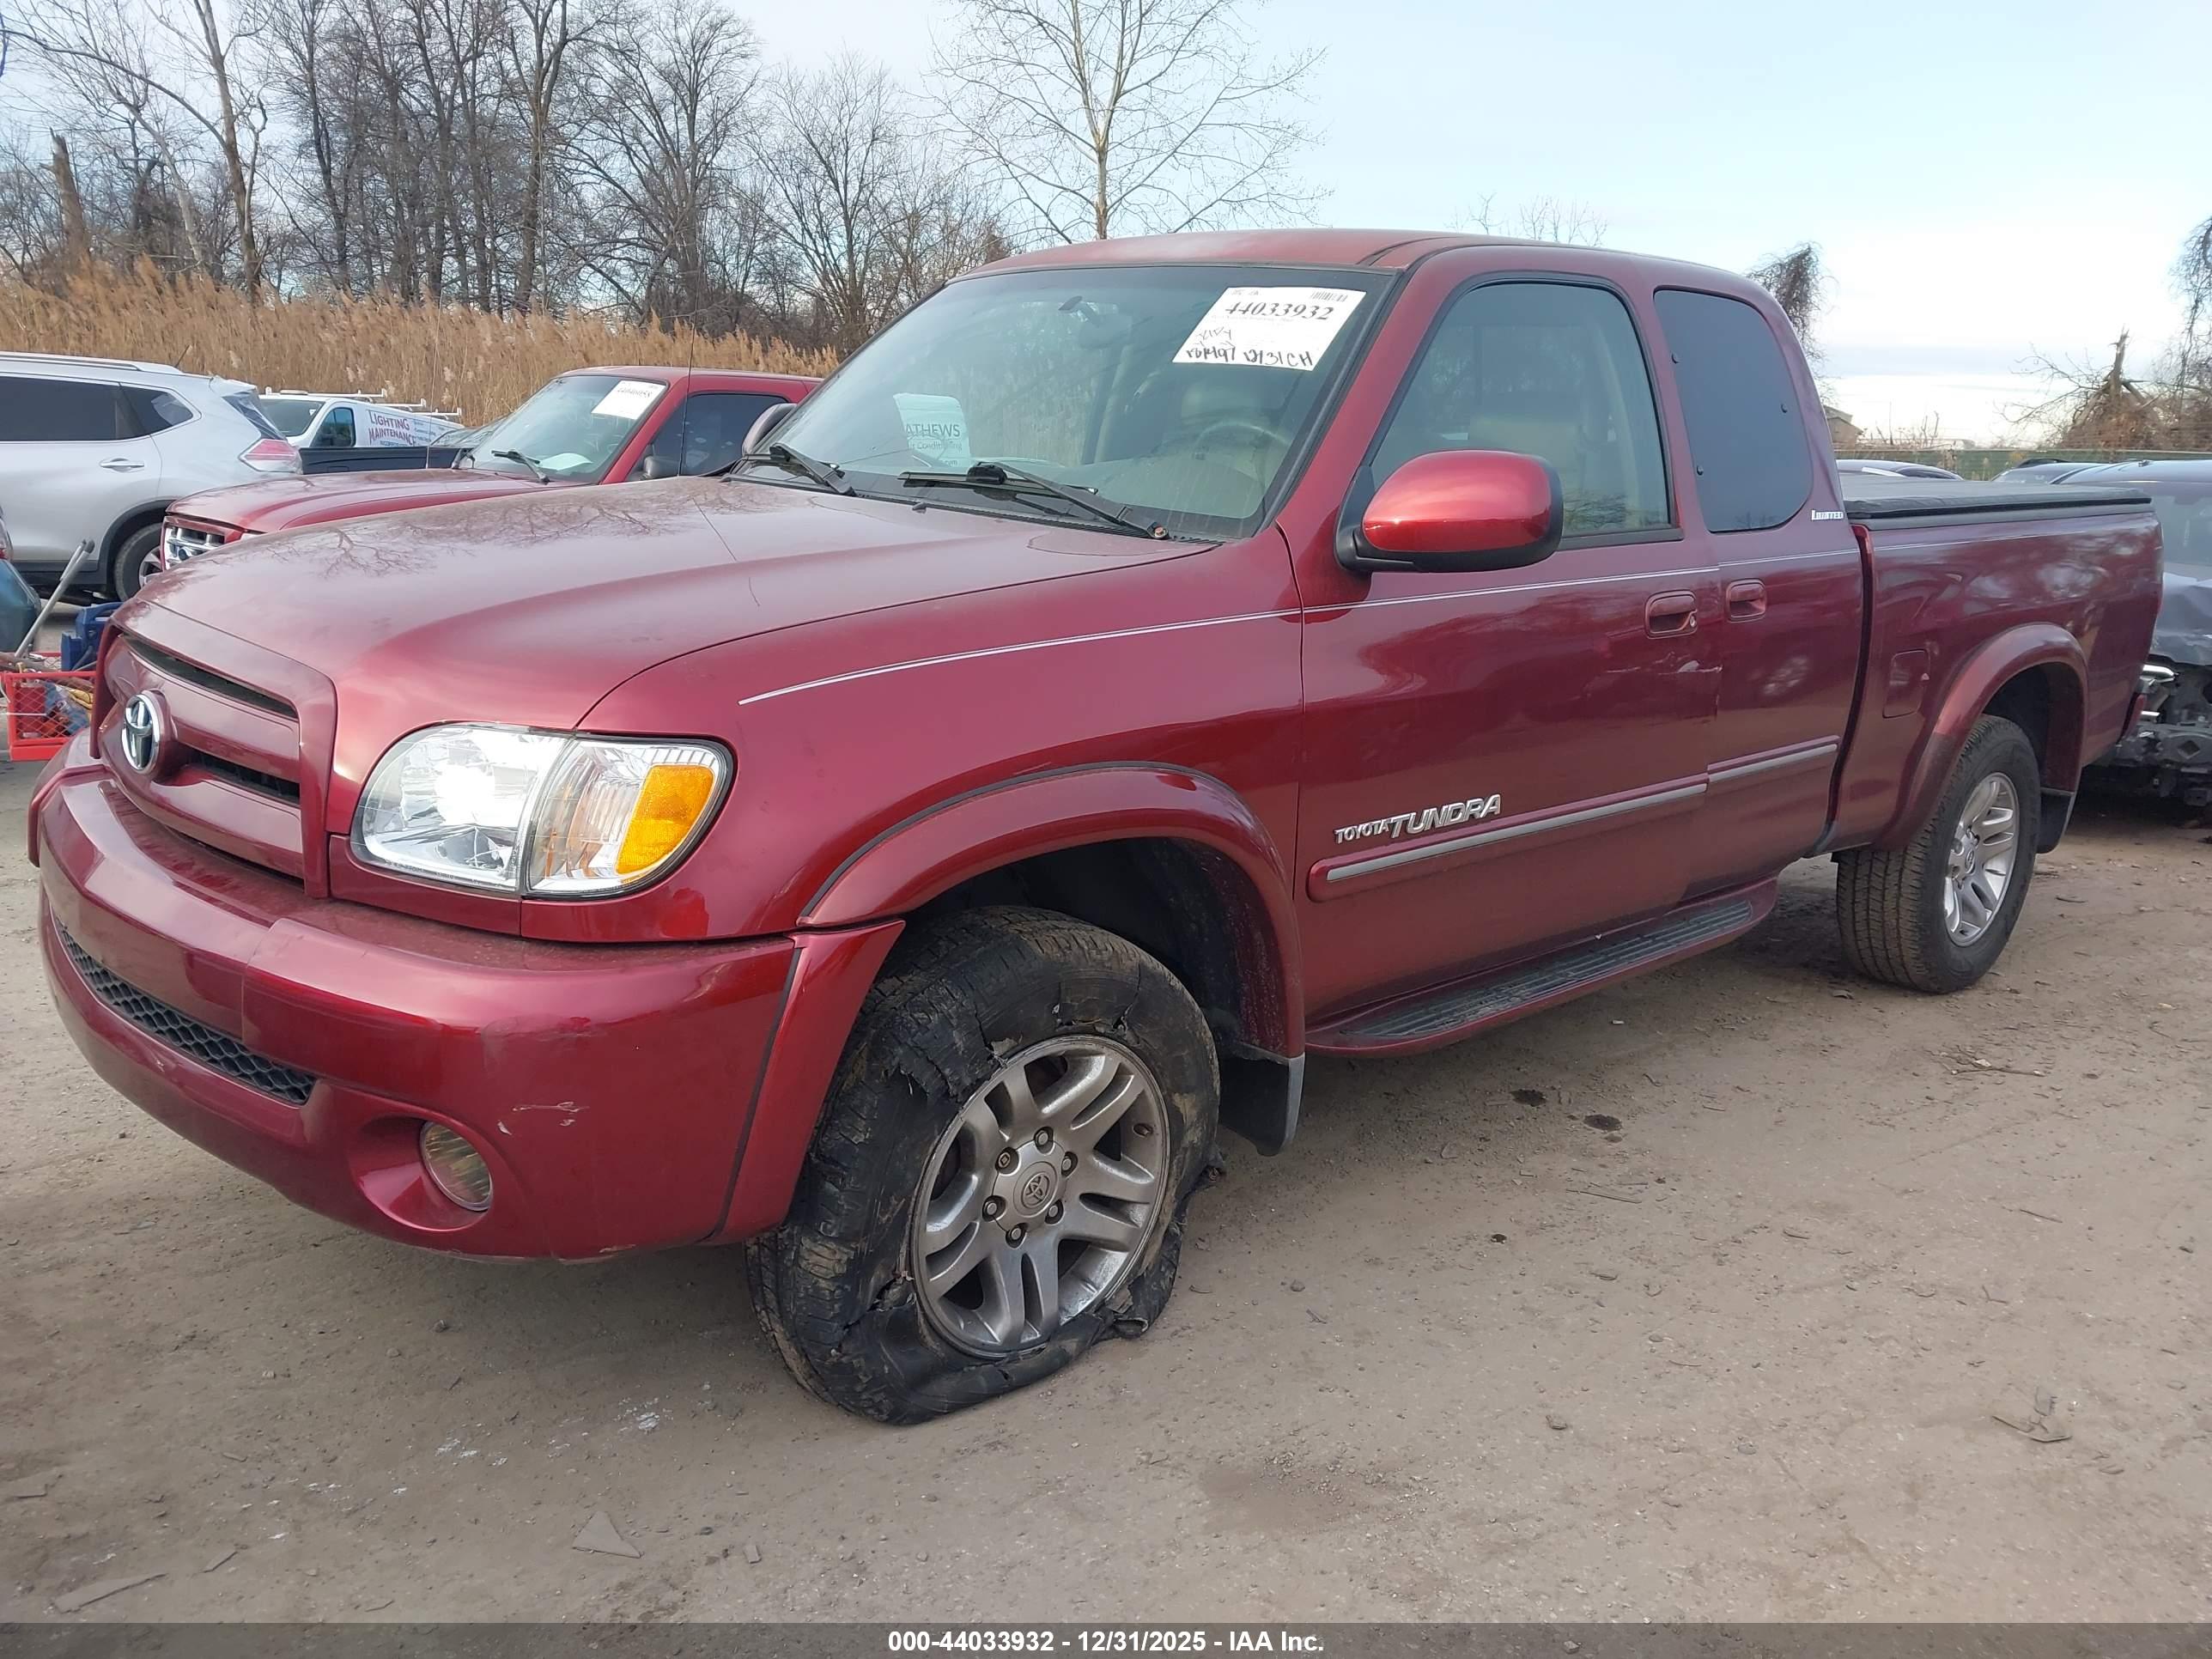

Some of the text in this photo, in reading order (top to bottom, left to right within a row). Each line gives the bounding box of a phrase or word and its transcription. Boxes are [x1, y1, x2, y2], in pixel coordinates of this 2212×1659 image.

[1224, 301, 1334, 321] 44033932
[369, 410, 410, 431] LIGHTING
[369, 428, 417, 447] MAINTENANCE
[1334, 793, 1502, 844] TOYOTA TUNDRA
